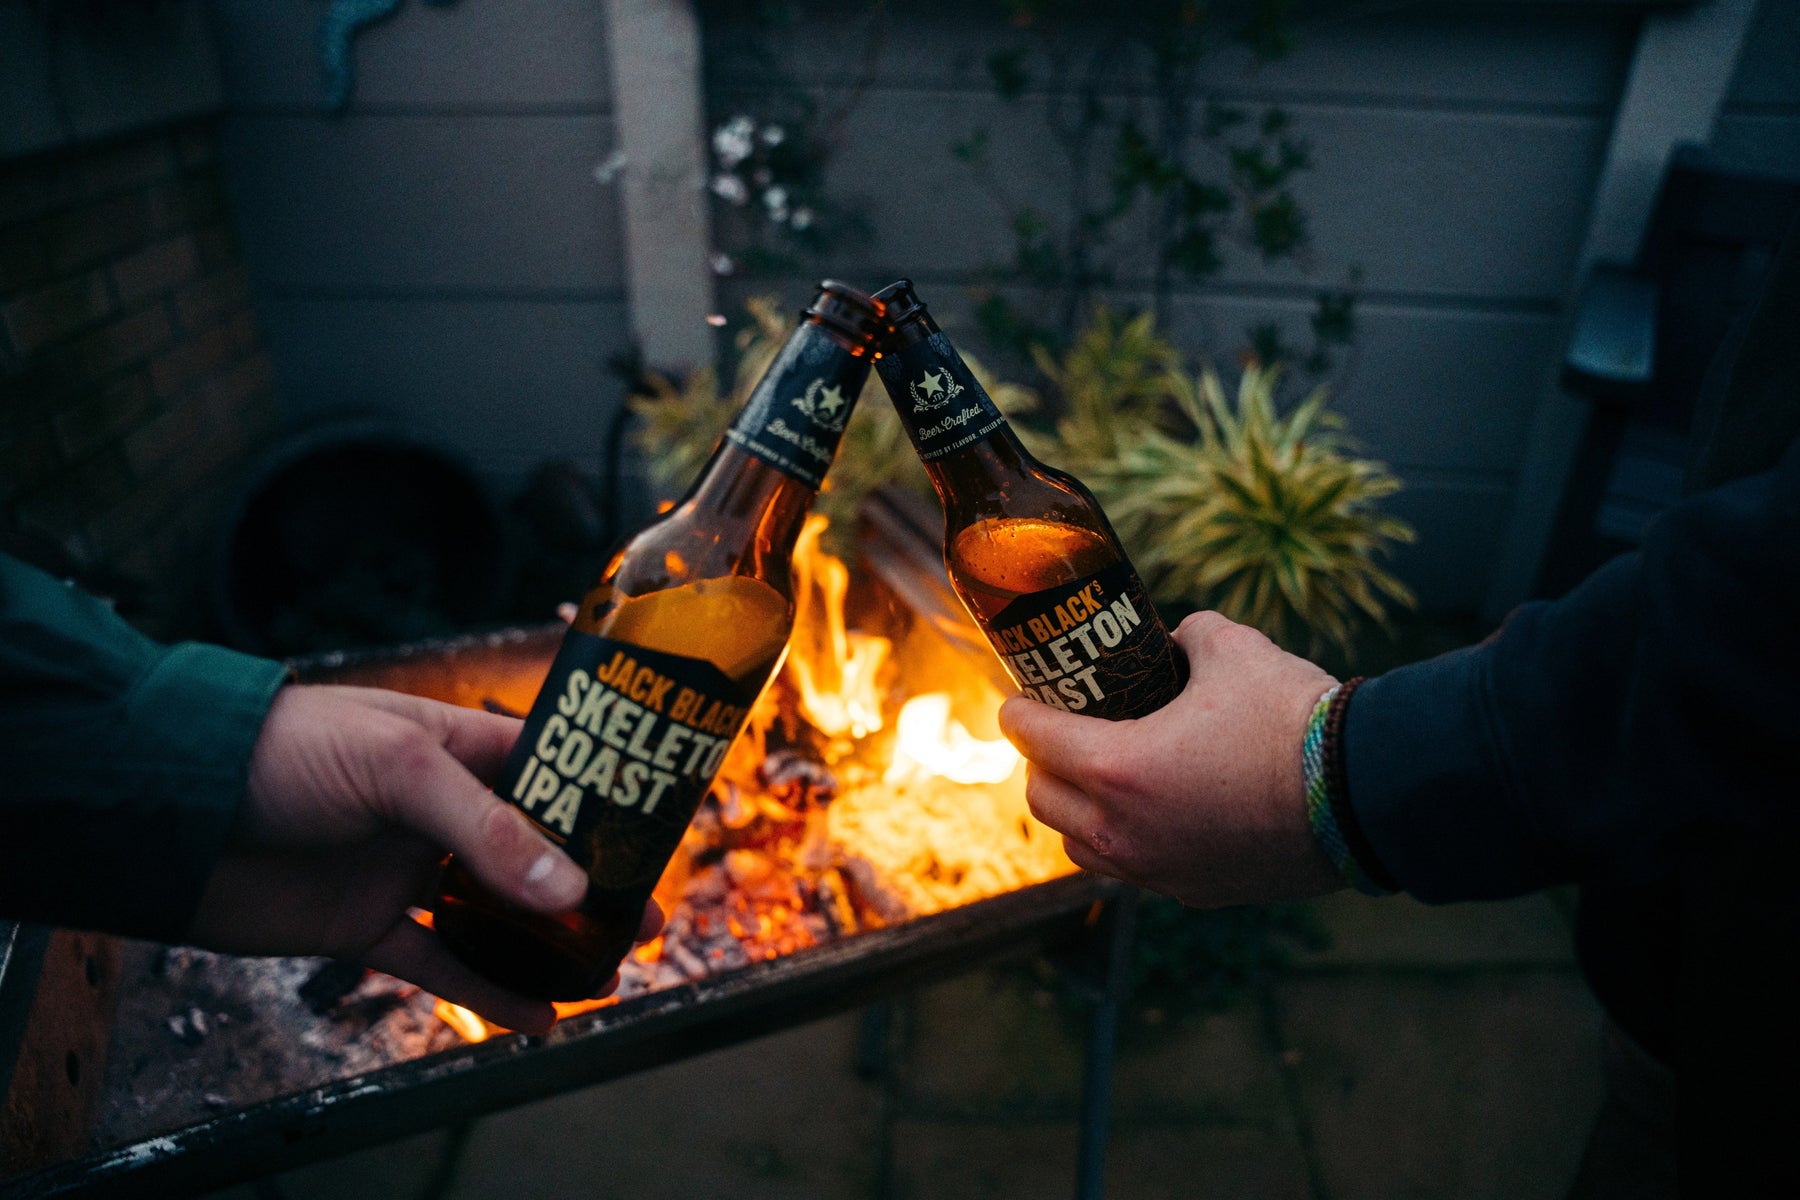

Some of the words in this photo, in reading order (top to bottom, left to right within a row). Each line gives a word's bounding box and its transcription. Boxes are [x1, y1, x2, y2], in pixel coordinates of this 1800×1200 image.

[941, 403, 983, 430] Crafted.
[989, 624, 1034, 655] ACK
[1005, 592, 1142, 686] KELETON
[597, 651, 676, 713] JACK
[558, 669, 730, 780] SKELETO
[512, 756, 584, 835] IPA
[536, 714, 678, 815] COAST
